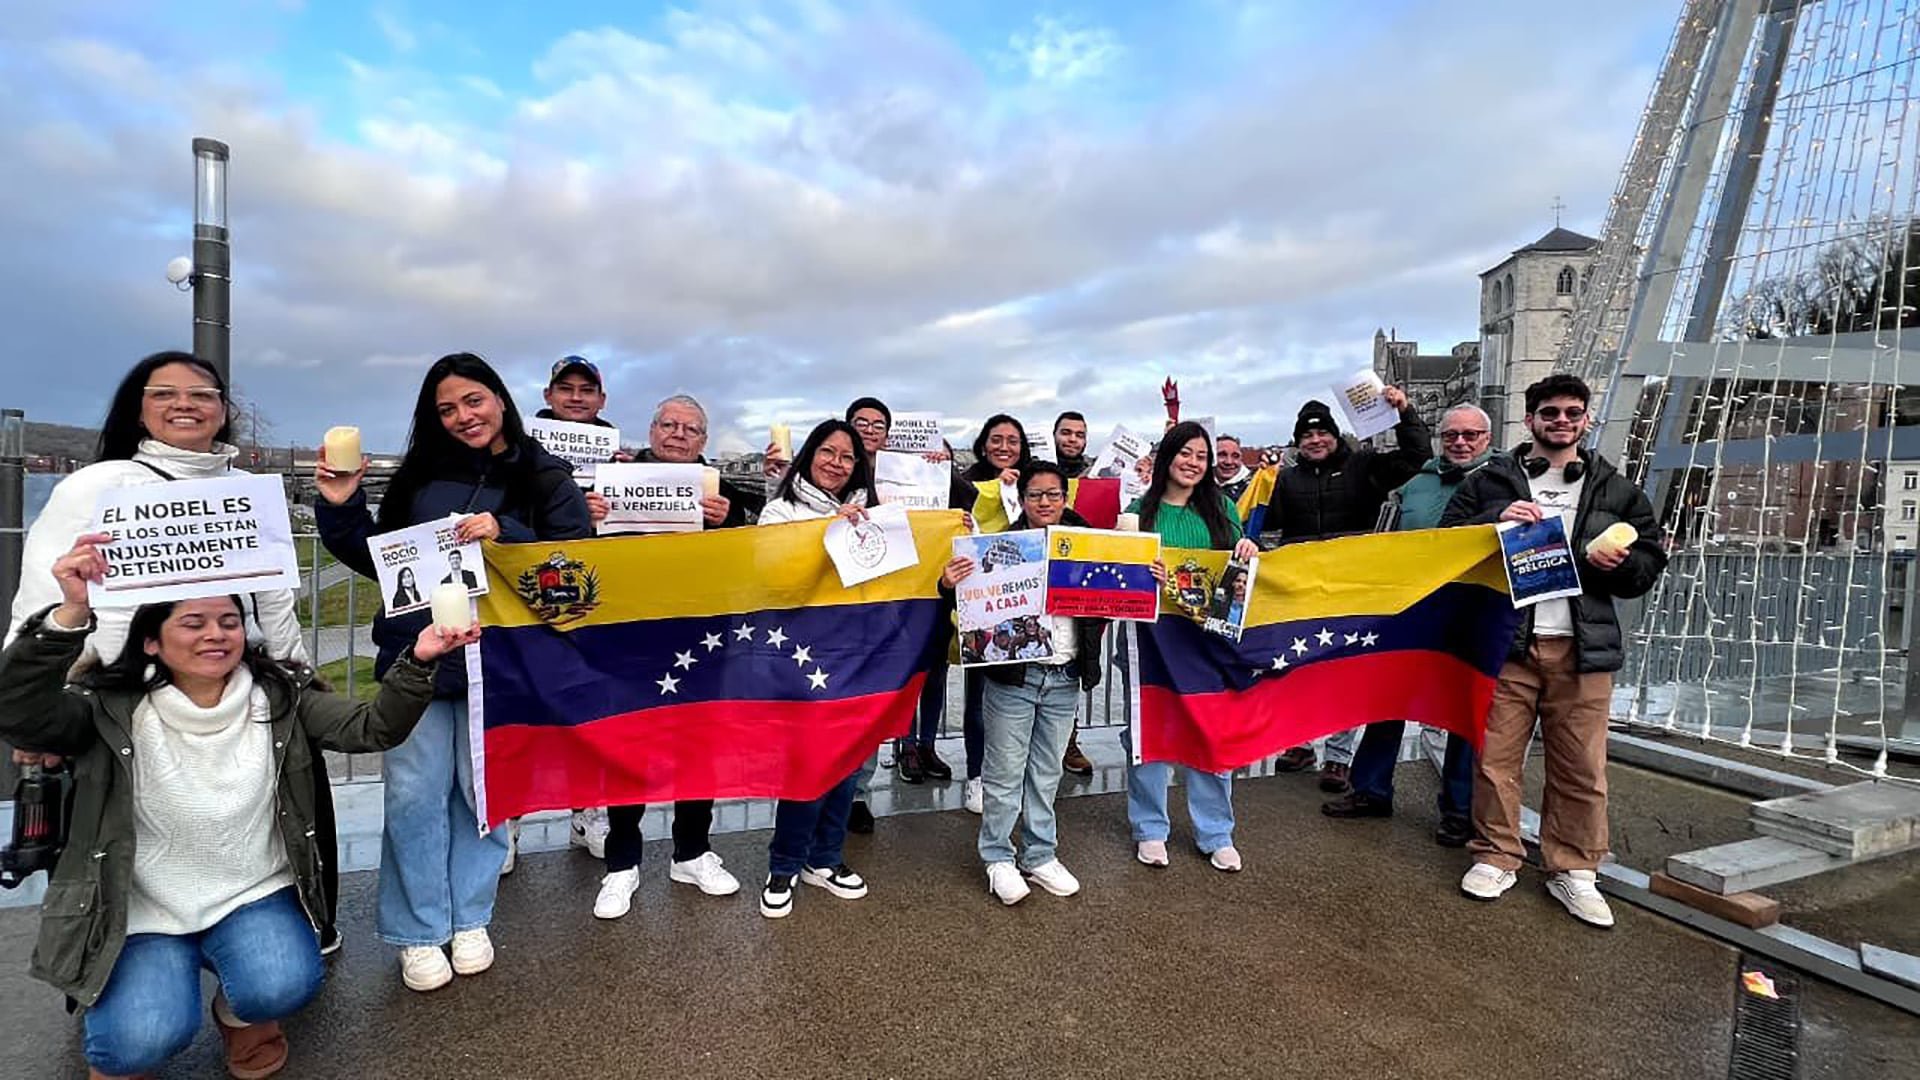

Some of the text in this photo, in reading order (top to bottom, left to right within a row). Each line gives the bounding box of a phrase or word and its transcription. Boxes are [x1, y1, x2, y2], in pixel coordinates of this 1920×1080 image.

[531, 428, 547, 440] EL
[550, 431, 592, 445] NOBEL
[595, 436, 611, 446] ES
[547, 443, 566, 453] LAS
[569, 445, 611, 457] MADRES
[603, 486, 694, 498] EL NOBEL ES
[103, 497, 251, 524] EL NOBEL ES
[623, 500, 697, 511] VENEZUELA
[126, 527, 159, 540] LOS
[164, 522, 199, 537] QUE
[204, 519, 257, 534] ESTÁN
[101, 536, 259, 560] INJUSTAMENTE
[105, 554, 224, 579] DETENIDOS
[985, 594, 1028, 612] A CASA
